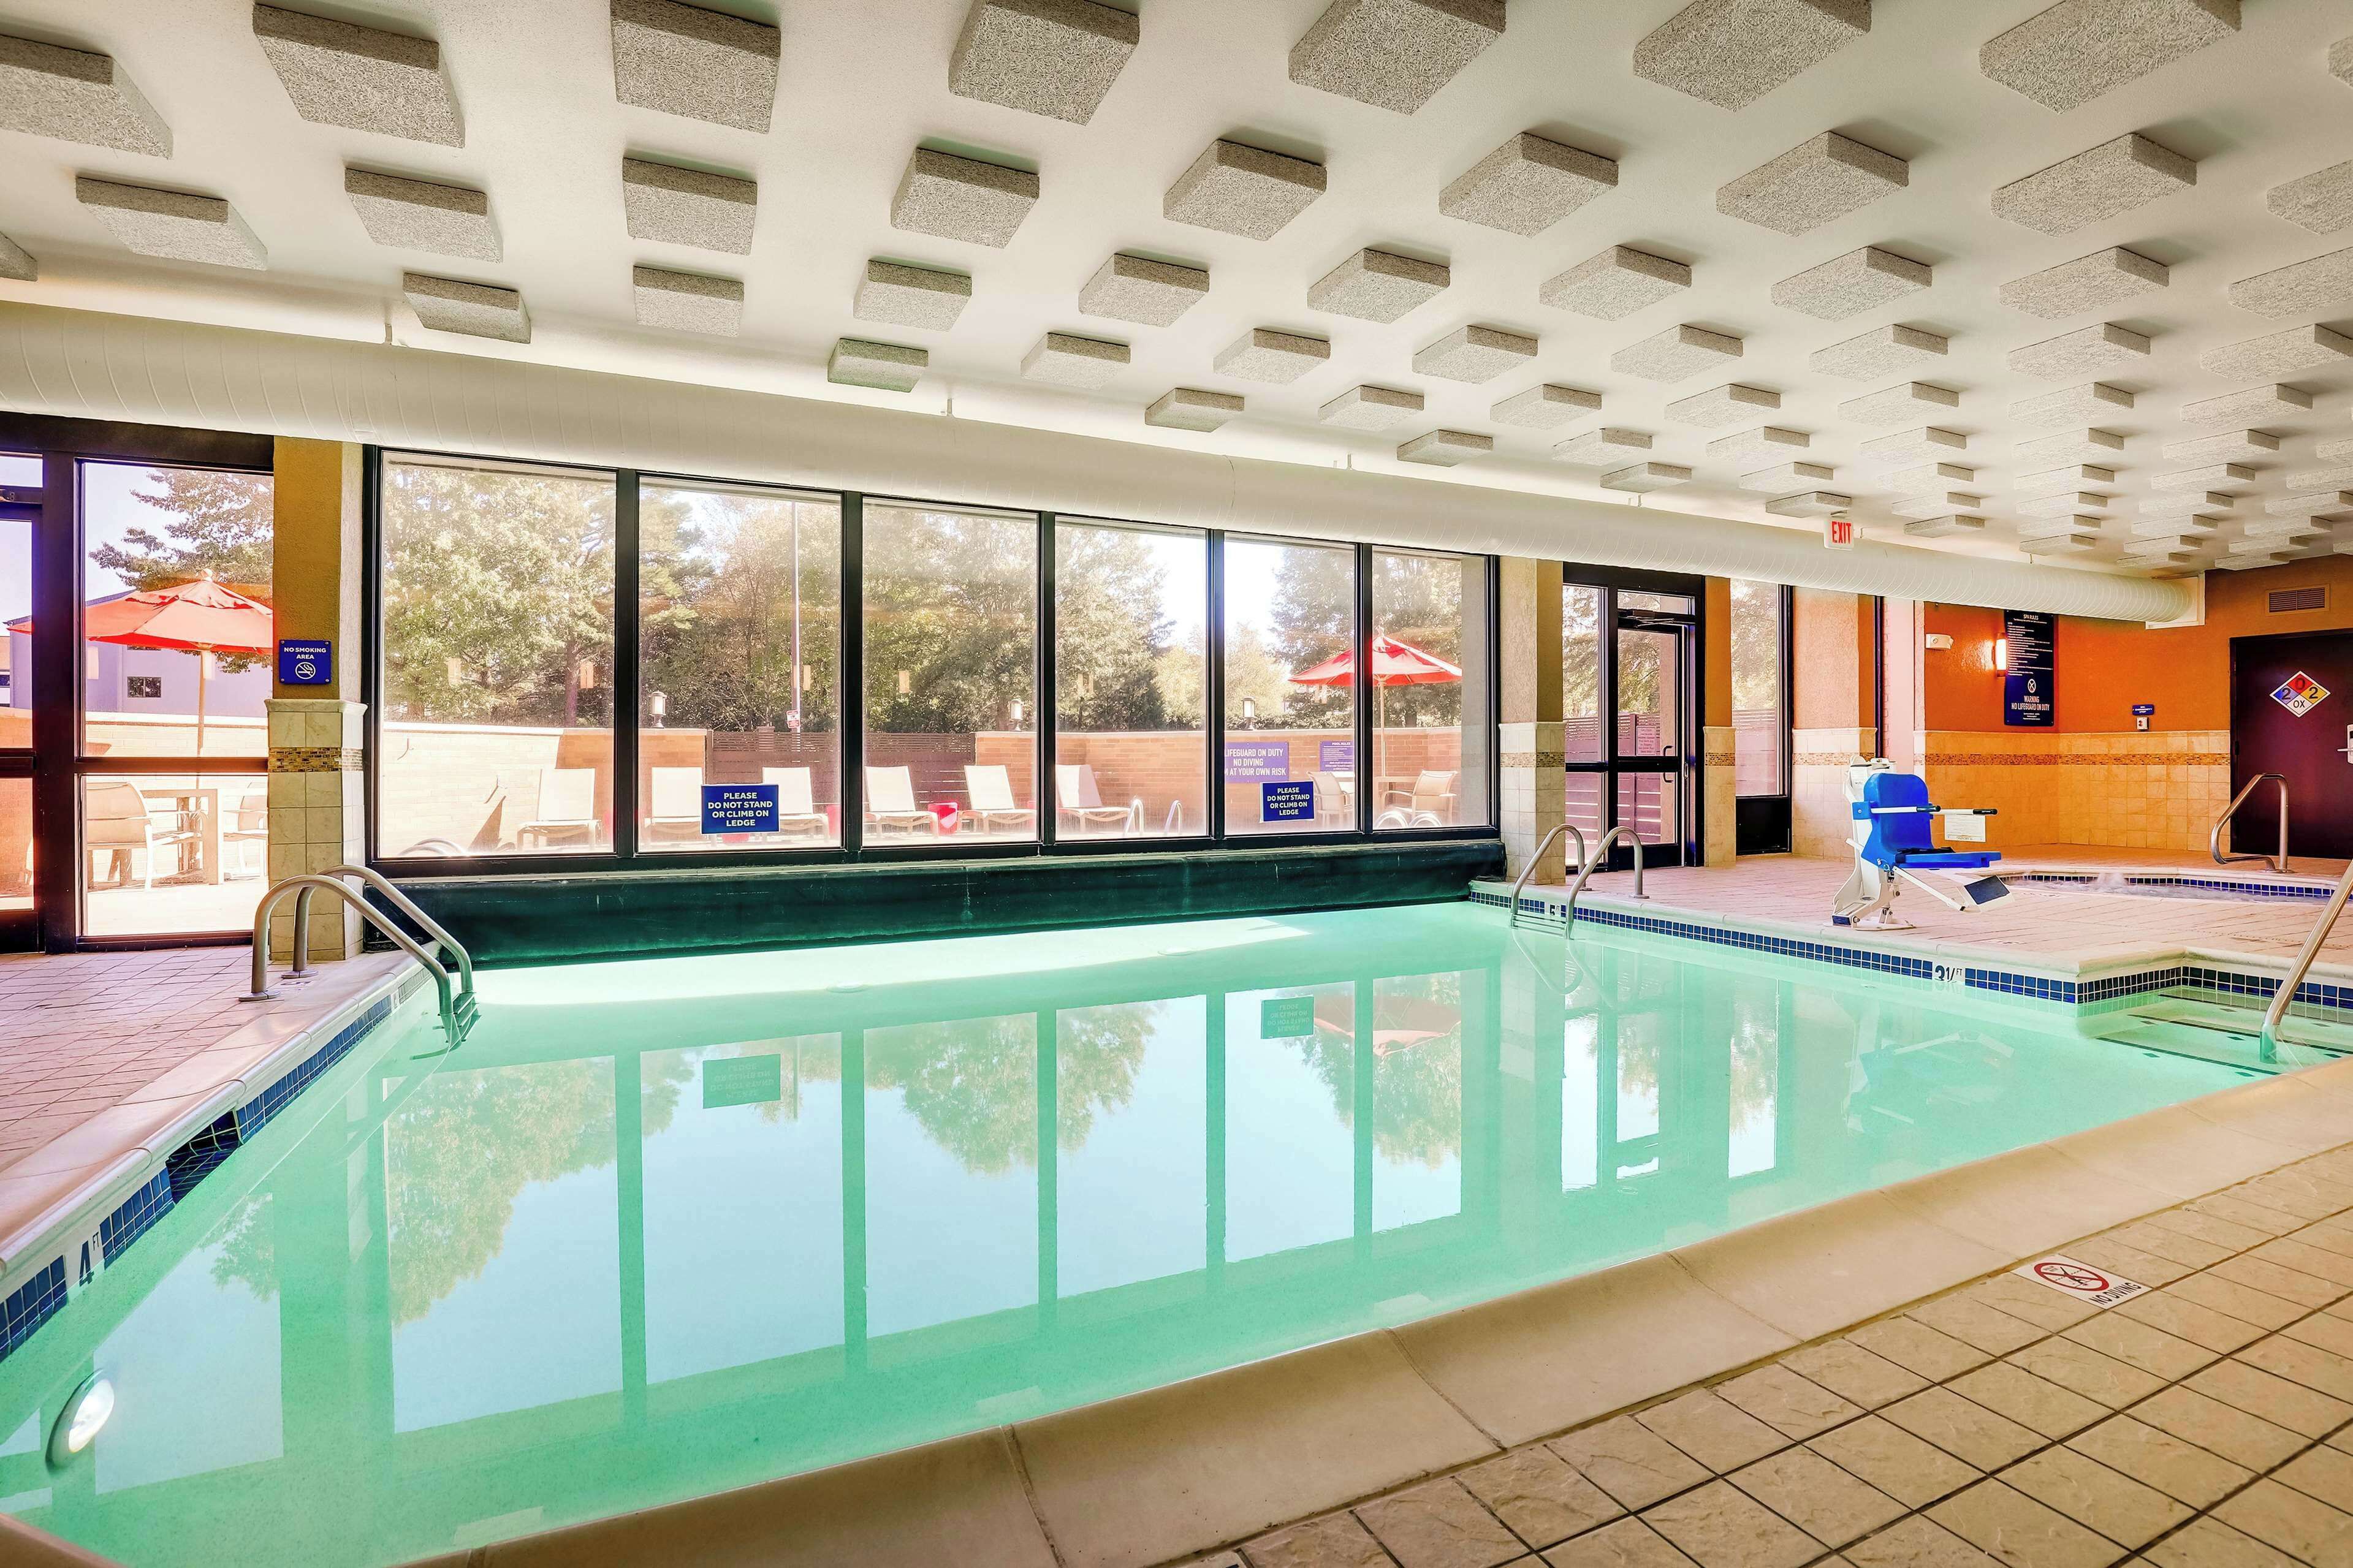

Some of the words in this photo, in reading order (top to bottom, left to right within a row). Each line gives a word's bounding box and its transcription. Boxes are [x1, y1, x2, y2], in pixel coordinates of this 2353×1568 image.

[1831, 521, 1852, 544] EXIT
[2295, 678, 2305, 690] 0
[2281, 687, 2291, 700] 2
[2309, 686, 2318, 699] 2
[1549, 904, 1555, 915] 5
[79, 1240, 95, 1287] 4
[92, 1232, 100, 1251] FT
[2089, 1295, 2113, 1305] NO
[2102, 1282, 2142, 1299] DIVING
